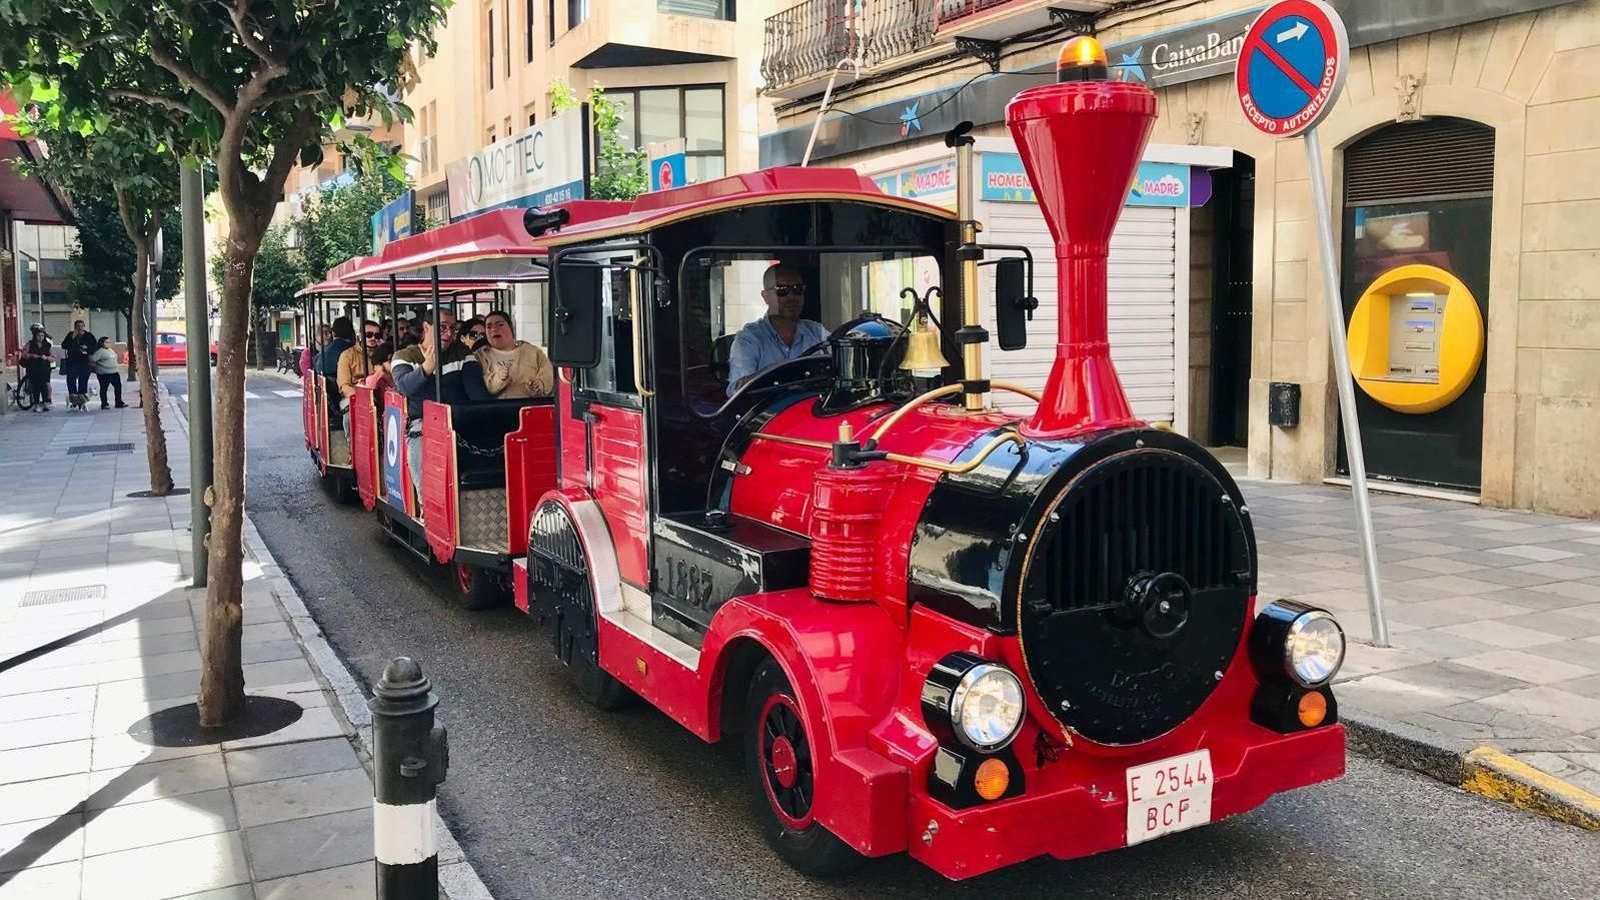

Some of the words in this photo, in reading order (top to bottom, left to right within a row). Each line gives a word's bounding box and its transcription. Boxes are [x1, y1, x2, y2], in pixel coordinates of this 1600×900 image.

[1151, 24, 1250, 70] CaixaBan
[1242, 93, 1277, 131] EXCEPTO
[1283, 57, 1335, 131] AUTORIZADOS
[915, 169, 951, 191] MADRE
[989, 173, 1031, 187] HOMEN
[1144, 181, 1179, 196] MADRE
[666, 555, 713, 612] 1887
[1131, 775, 1142, 803] E
[1155, 760, 1207, 796] 2544
[1147, 798, 1190, 832] BCF
